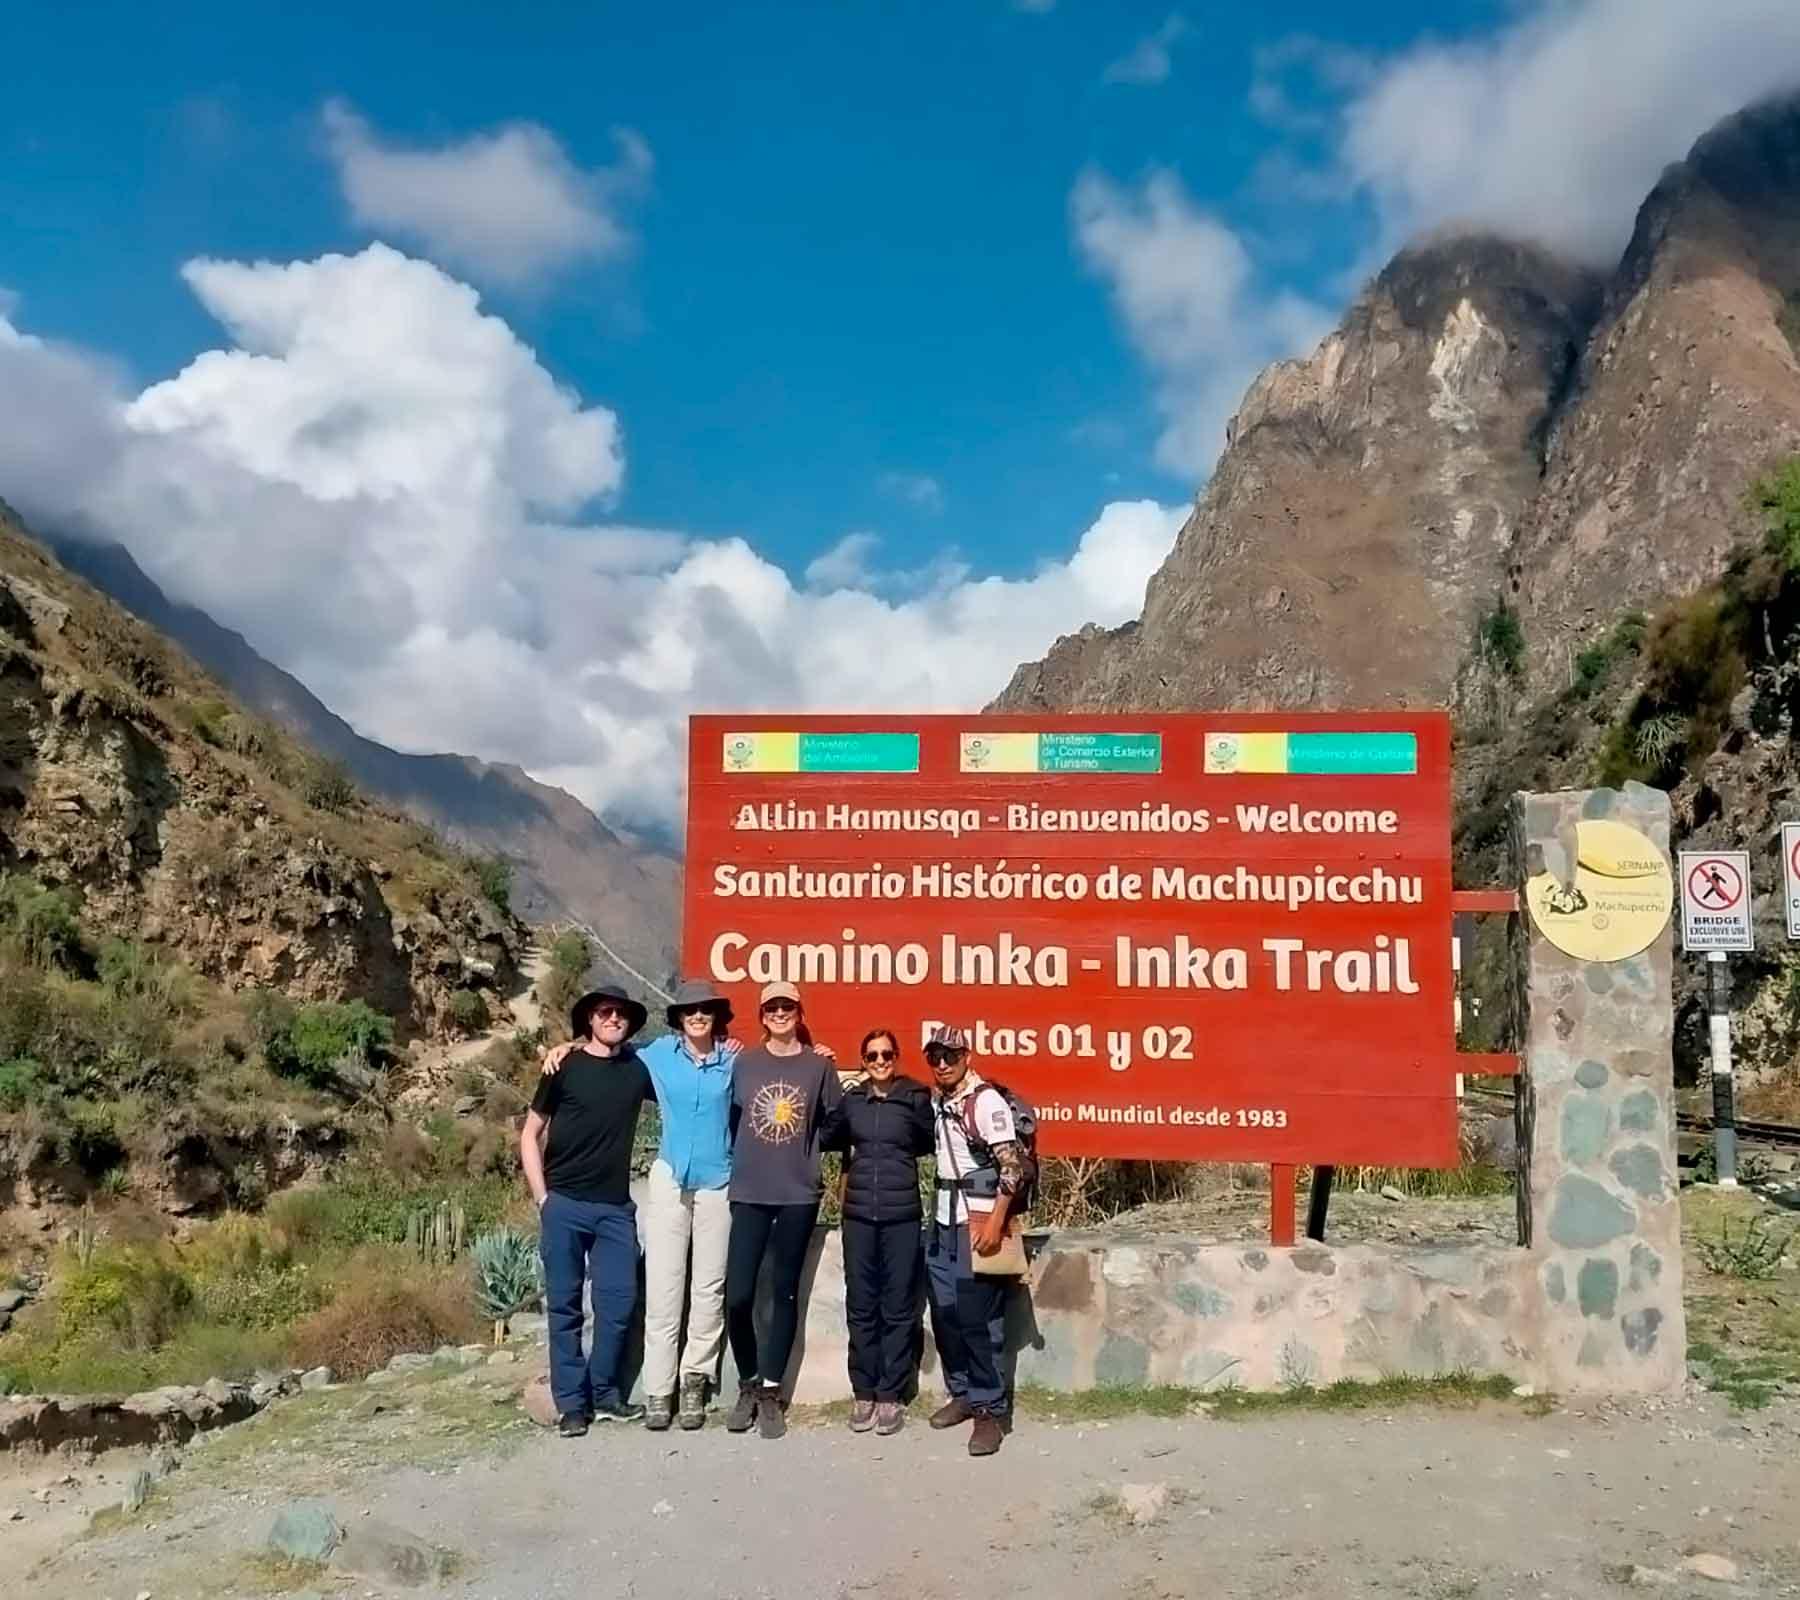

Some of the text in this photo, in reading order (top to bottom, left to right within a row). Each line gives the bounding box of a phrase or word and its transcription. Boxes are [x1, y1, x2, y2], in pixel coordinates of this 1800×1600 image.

[1041, 734, 1097, 745] Ministerio
[1053, 757, 1099, 769] Turismo
[1058, 746, 1112, 757] Comercio
[1113, 746, 1156, 758] Exterior
[735, 800, 817, 830] Allin
[827, 804, 980, 838] Hamusqa
[1007, 802, 1210, 832] Bienvenidos
[1235, 803, 1398, 833] Welcome
[713, 859, 1423, 911] Santuario Histórico de Machupicchu
[1693, 916, 1742, 925] BRIDGE
[709, 928, 929, 984] Camino
[941, 933, 1068, 986] Inka
[1116, 935, 1248, 989] Inka
[1262, 935, 1420, 993] Trail
[1049, 1023, 1097, 1057] 01
[1107, 1031, 1132, 1071] y
[1142, 1026, 1194, 1060] 02
[1077, 1104, 1165, 1123] Mundial
[1169, 1105, 1231, 1126] desde
[1236, 1109, 1287, 1128] 1983
